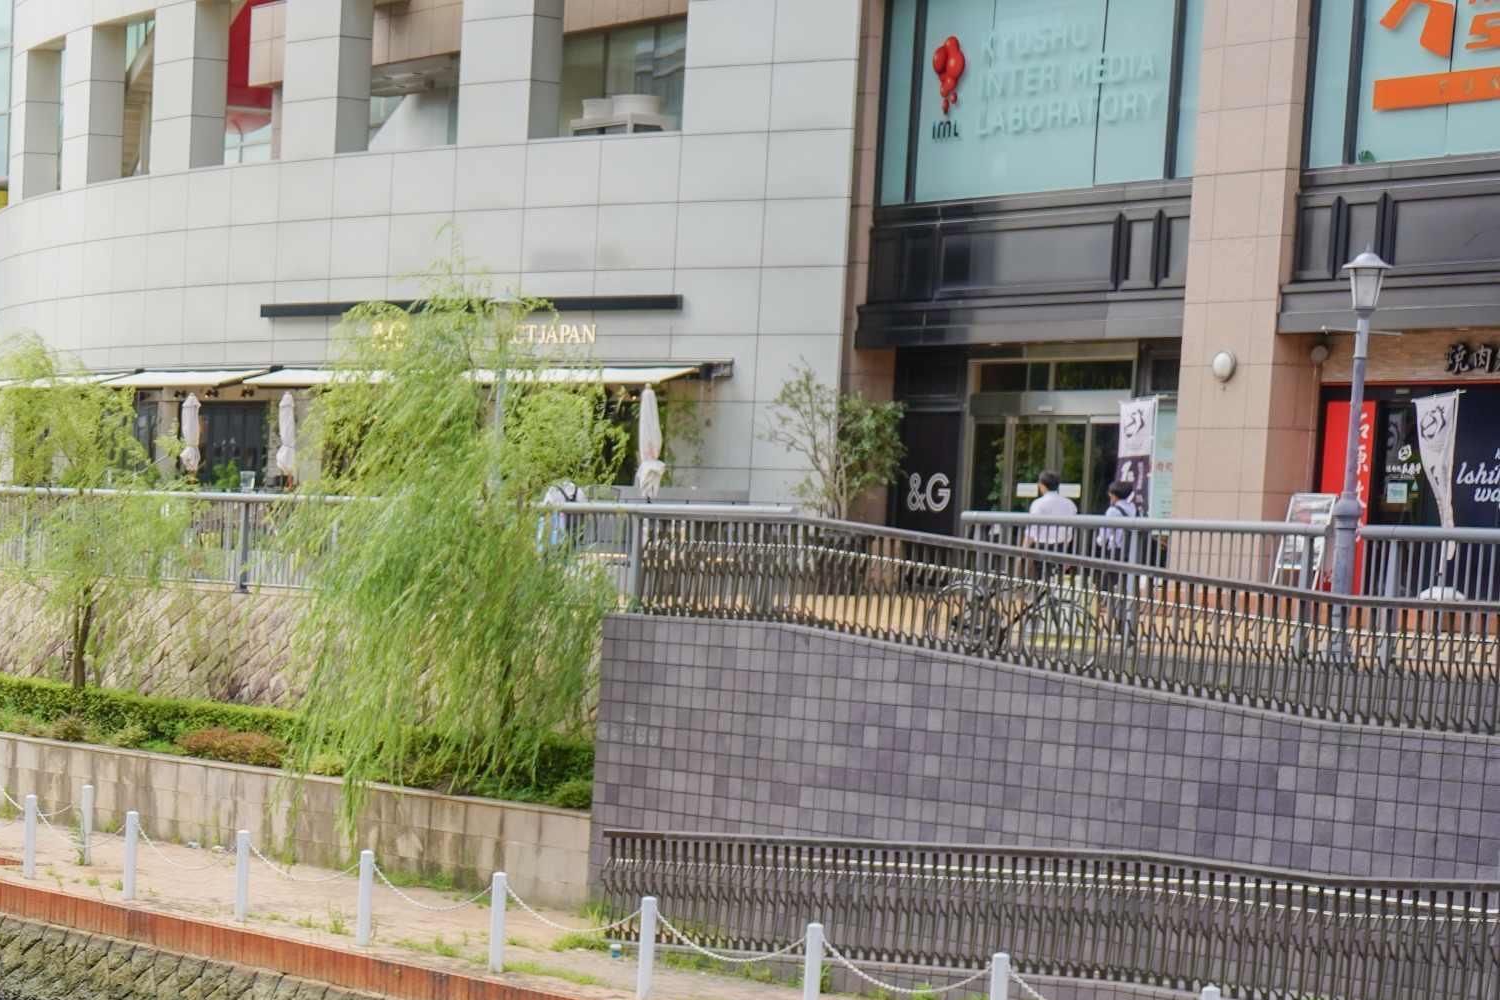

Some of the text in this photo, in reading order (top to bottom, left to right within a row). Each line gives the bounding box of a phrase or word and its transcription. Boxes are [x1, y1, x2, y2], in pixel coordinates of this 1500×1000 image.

[981, 22, 1089, 59] KYUSHU
[979, 53, 1156, 98] INTER MEDIA
[975, 90, 1161, 136] LABORATORY
[538, 323, 597, 344] JAPAN
[1444, 343, 1500, 374] 焼肉
[907, 472, 951, 511] &G
